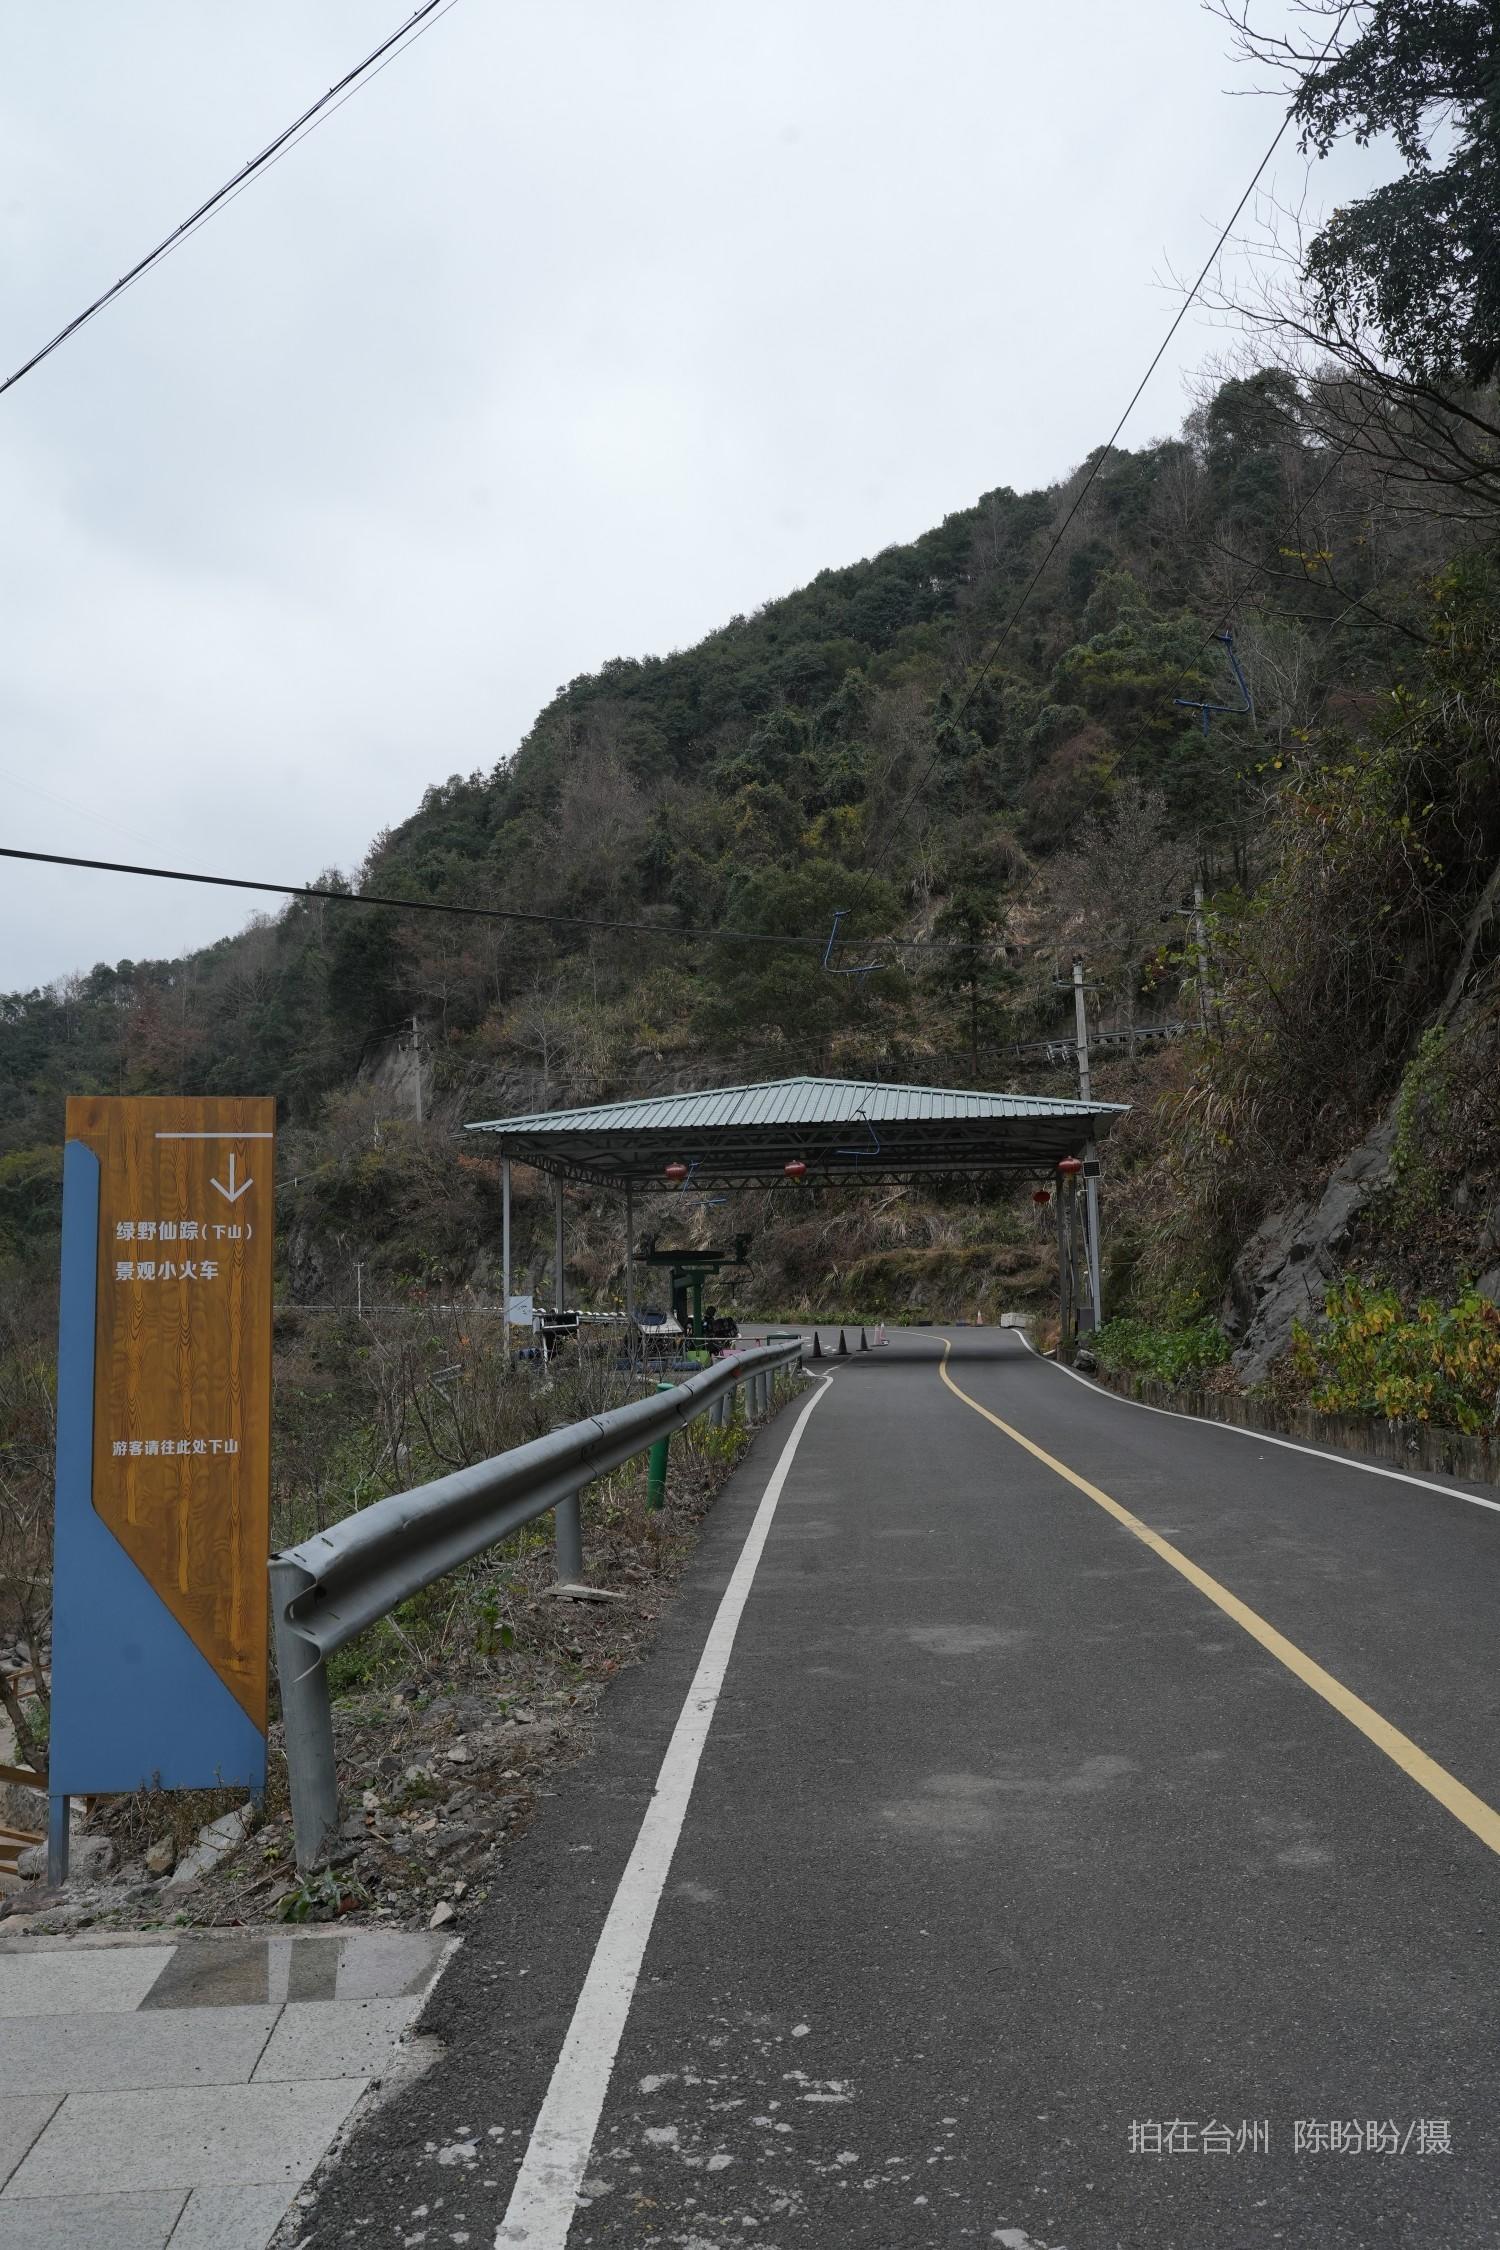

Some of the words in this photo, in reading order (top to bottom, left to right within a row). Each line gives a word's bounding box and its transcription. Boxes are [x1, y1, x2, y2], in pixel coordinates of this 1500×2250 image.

[115, 1260, 219, 1281] 景观小火车
[112, 1438, 238, 1456] 游客请往此处下山
